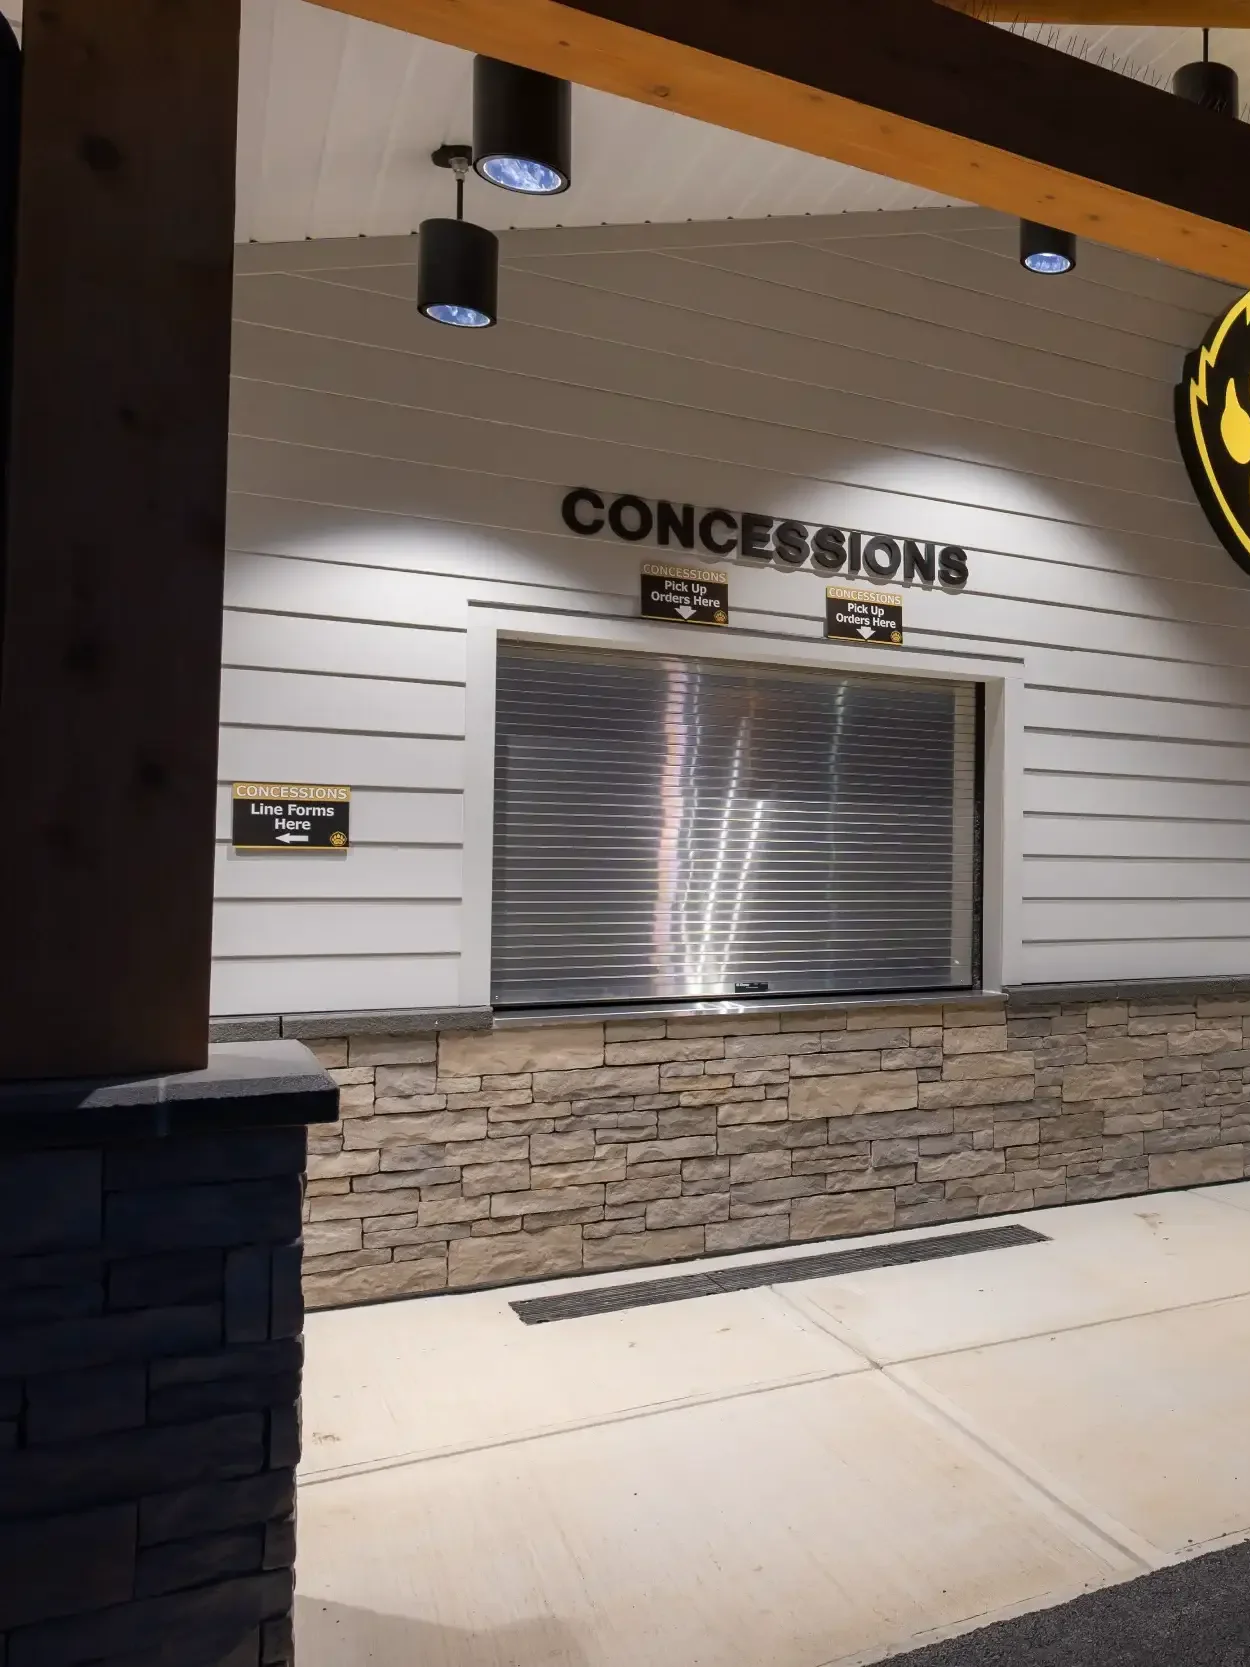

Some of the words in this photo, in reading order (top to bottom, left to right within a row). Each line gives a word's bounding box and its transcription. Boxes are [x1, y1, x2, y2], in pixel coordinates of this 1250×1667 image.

[561, 488, 969, 585] CONCESSIONS
[643, 563, 726, 582] CONCESSIONS
[664, 580, 689, 593] Pick
[691, 583, 707, 596] Up
[829, 587, 901, 605] CONCESSIONS
[651, 590, 690, 605] Orders
[693, 595, 720, 608] Here
[847, 602, 869, 614] Pick
[870, 605, 885, 618] Up
[835, 612, 870, 626] Orders
[872, 617, 896, 629] Here
[236, 785, 347, 800] CONCESSIONS
[251, 803, 283, 815] Line
[287, 804, 335, 817] Forms
[274, 818, 311, 830] Here
